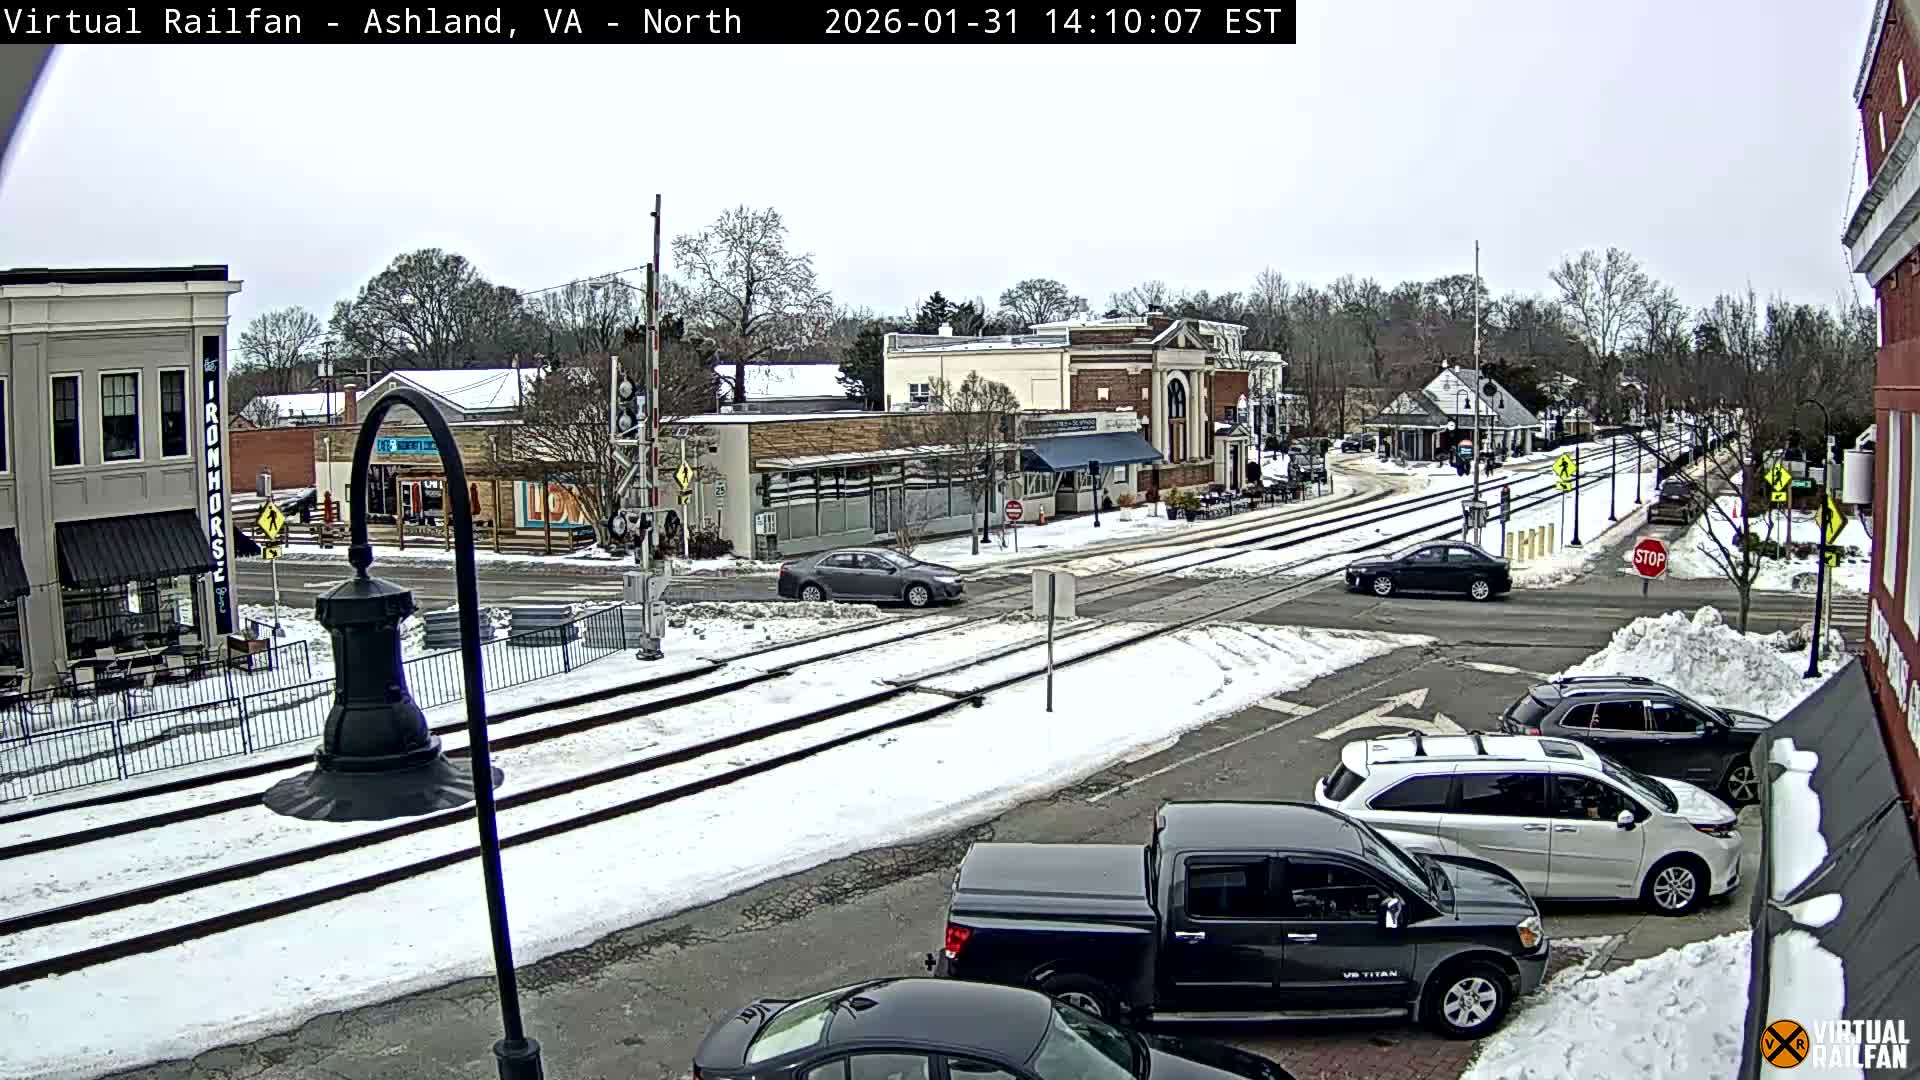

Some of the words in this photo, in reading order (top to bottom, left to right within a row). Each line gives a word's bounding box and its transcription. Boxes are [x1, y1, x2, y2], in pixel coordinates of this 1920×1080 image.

[205, 380, 225, 583] IRONHORSE
[1634, 548, 1666, 567] STOP
[1362, 970, 1398, 978] TITAN
